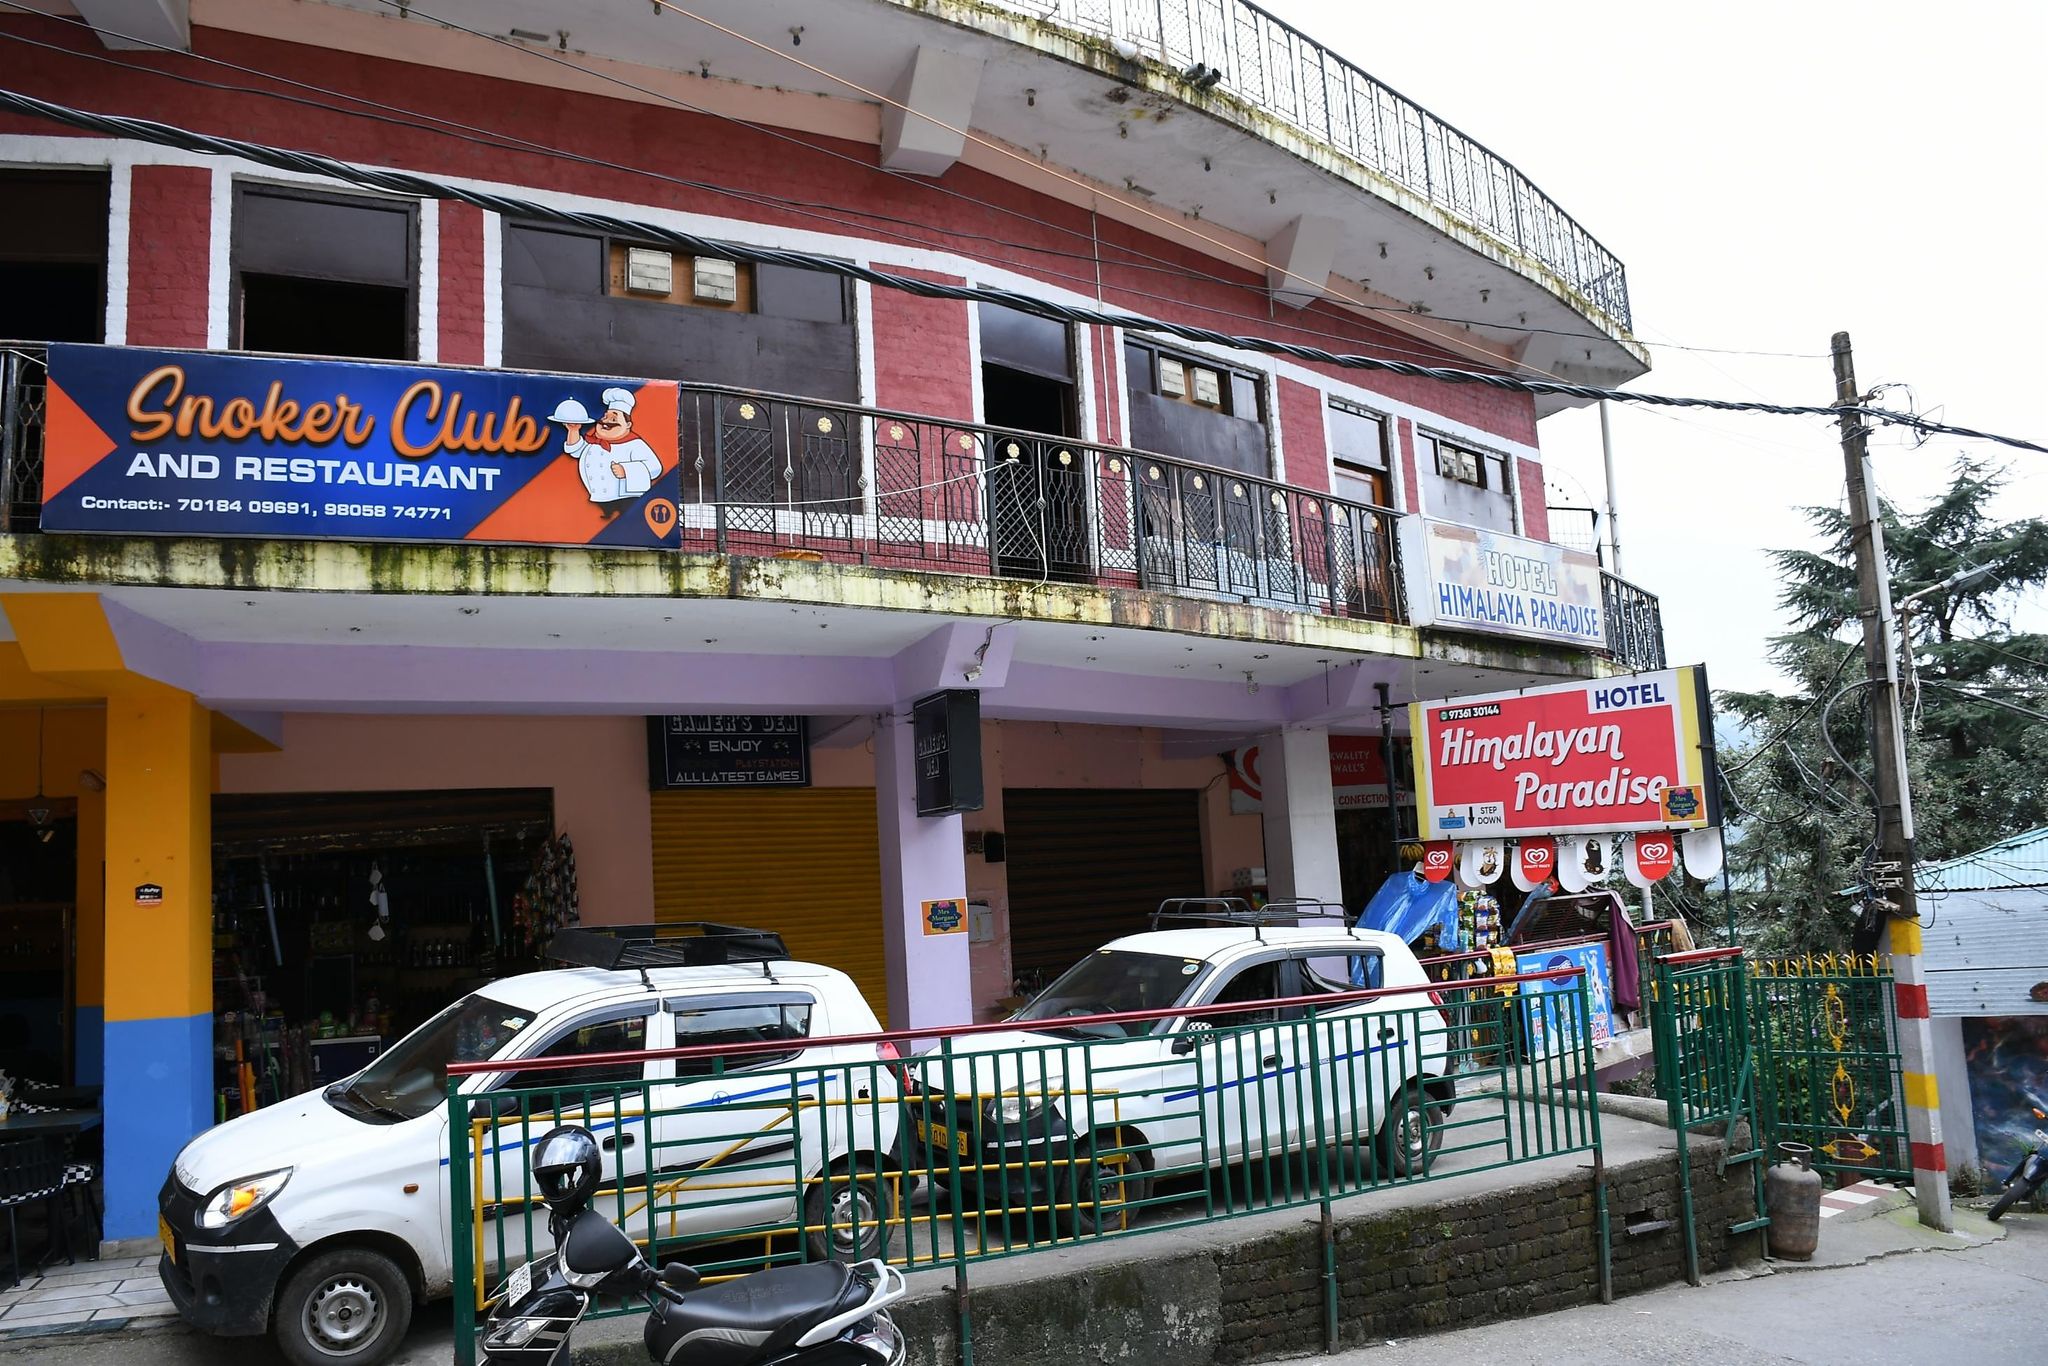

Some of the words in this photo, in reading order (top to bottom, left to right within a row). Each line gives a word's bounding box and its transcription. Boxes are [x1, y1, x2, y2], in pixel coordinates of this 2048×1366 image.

[126, 364, 375, 443] Snoker
[390, 379, 550, 458] Club
[126, 453, 220, 479] AND
[235, 456, 501, 491] RESTAURANT
[81, 496, 171, 511] Contact:-
[177, 498, 242, 512] 70184
[248, 501, 318, 517] 09691,
[324, 503, 386, 518] 98058
[392, 506, 451, 520] 74771
[1485, 550, 1558, 596] HOTEL
[1438, 582, 1527, 626] HIMALAYA
[1530, 598, 1600, 637] PARADISE
[1595, 683, 1665, 710] HOTEL
[1448, 708, 1472, 720] 97361
[1473, 705, 1499, 717] 30144
[671, 715, 753, 732] GAMER'S
[762, 715, 798, 732] DEN
[708, 740, 763, 752] ENJOY
[1440, 721, 1624, 771] Himalayan
[674, 772, 701, 782] ALL
[702, 771, 757, 782] LATEST
[757, 770, 800, 781] GAMES
[1334, 763, 1365, 773] WALL'S
[1338, 792, 1407, 806] CONFECTIONRY
[1514, 767, 1668, 811] Paradise
[1480, 806, 1497, 814] STEP
[1478, 816, 1502, 825] DOWN
